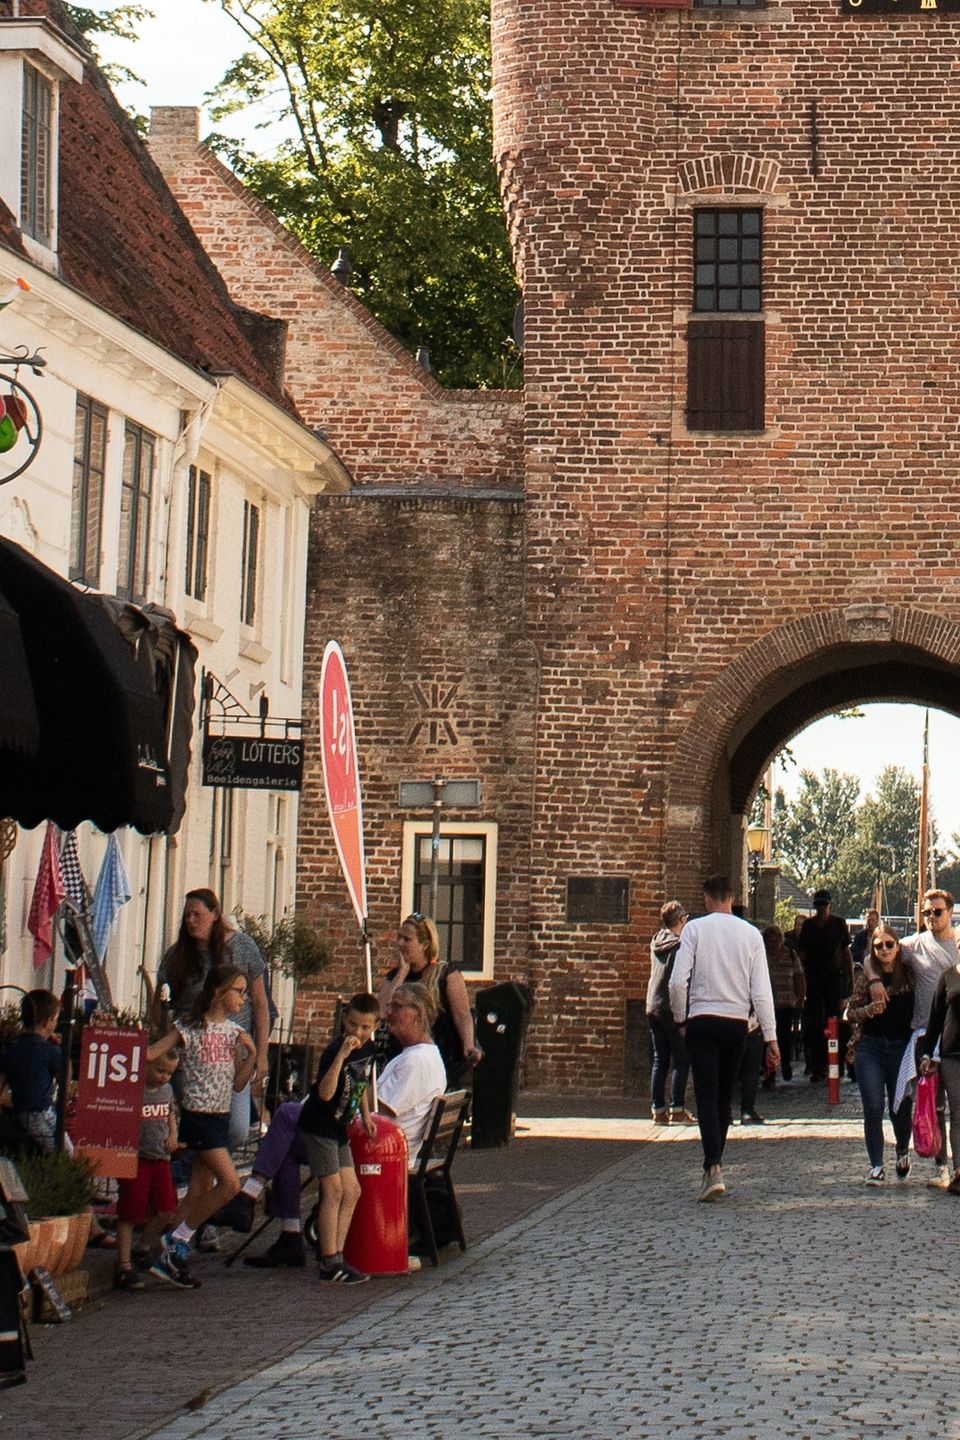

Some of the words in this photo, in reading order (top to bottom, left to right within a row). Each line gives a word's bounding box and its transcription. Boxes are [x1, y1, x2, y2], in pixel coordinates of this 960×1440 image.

[242, 740, 300, 765] LÖTTERS
[207, 774, 297, 786] Beeldengalerie
[87, 1042, 141, 1088] ijs!
